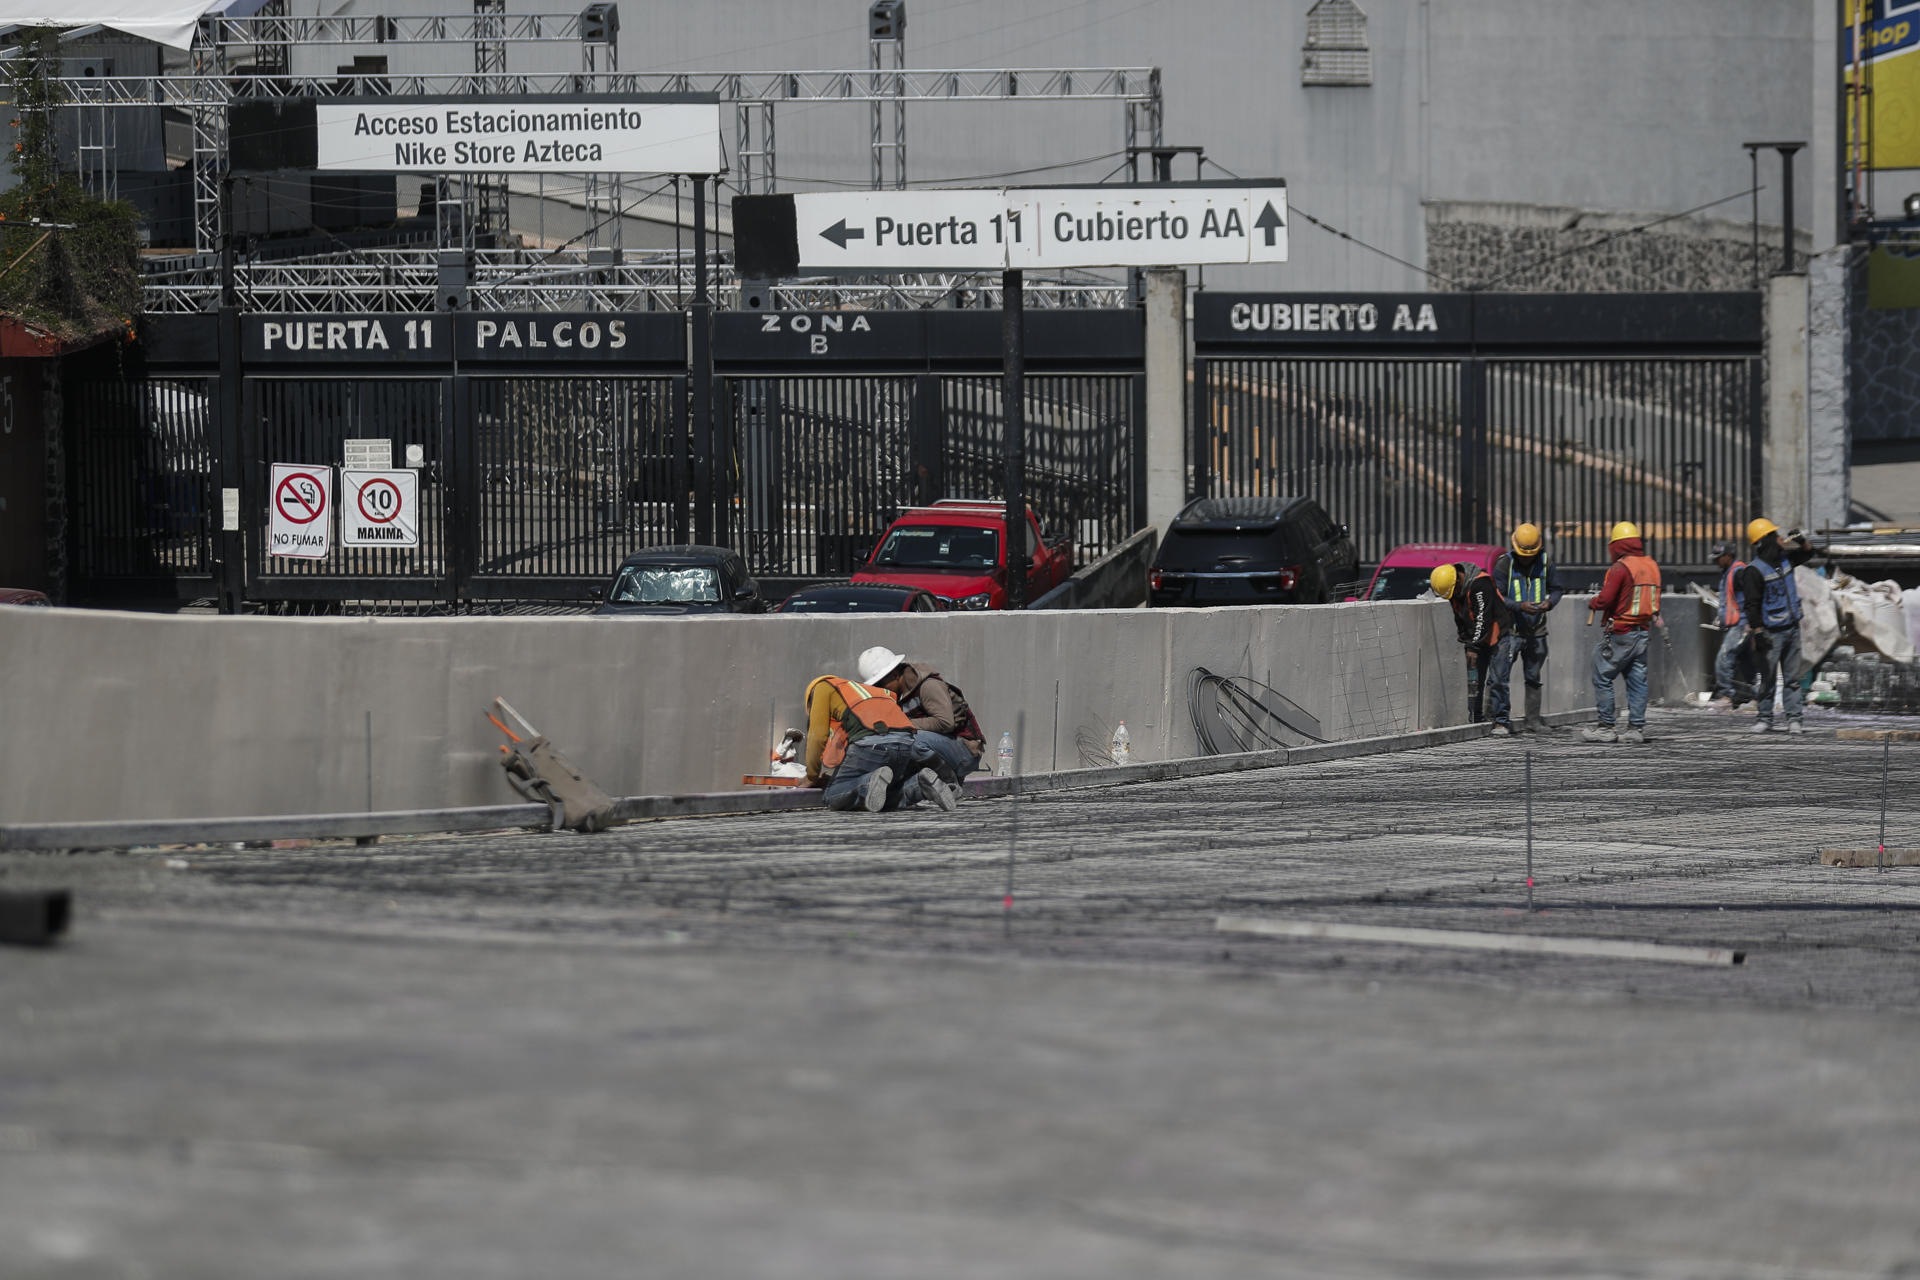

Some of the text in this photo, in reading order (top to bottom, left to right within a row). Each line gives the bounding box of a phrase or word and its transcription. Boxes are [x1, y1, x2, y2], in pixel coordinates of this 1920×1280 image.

[354, 104, 642, 136] Acceso Estacionamiento
[395, 140, 603, 166] Nike Store Azteca
[875, 216, 1023, 247] Puerta 11
[1054, 209, 1246, 242] Cubierto AA
[761, 314, 872, 333] ZONA
[1230, 301, 1439, 332] CUBIERTO AA
[263, 319, 433, 351] PUERTA 11
[476, 319, 628, 350] PALCOS
[810, 335, 828, 355] B
[366, 489, 392, 510] 10
[273, 533, 324, 547] NO FUMAR
[357, 527, 404, 540] MAXIMA
